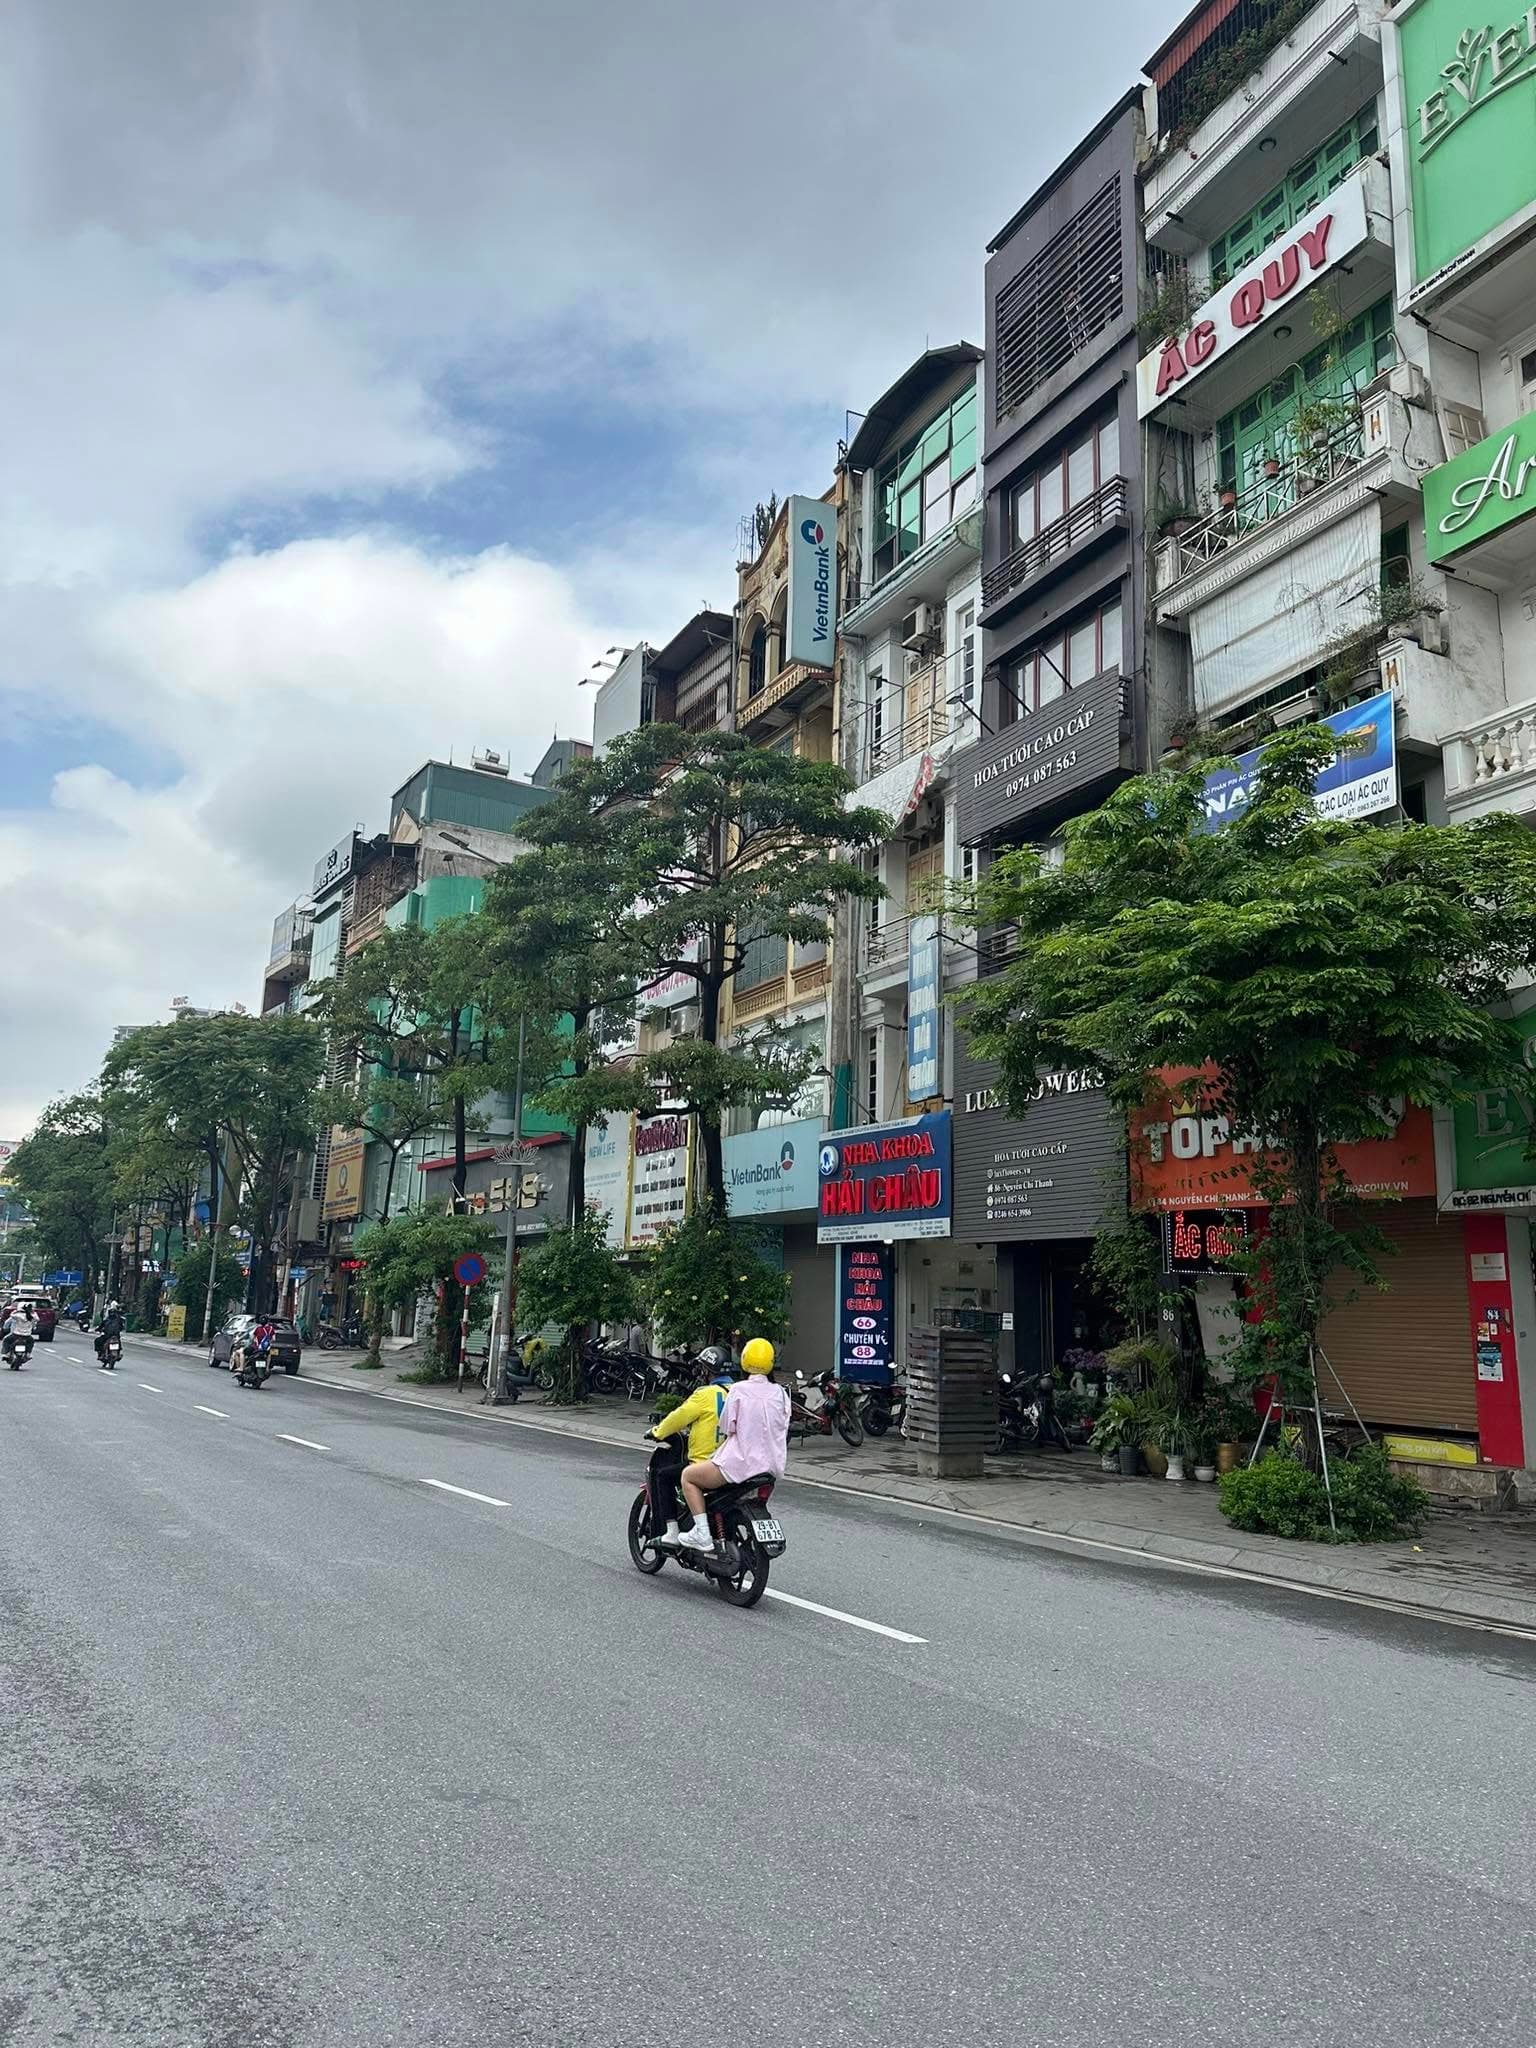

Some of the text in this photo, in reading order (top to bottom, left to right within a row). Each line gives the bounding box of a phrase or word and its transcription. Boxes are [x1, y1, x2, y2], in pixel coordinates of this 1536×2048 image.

[1155, 214, 1333, 396] ẮC QUY
[812, 545, 829, 642] VietinBank
[973, 703, 1094, 788] HOA TƯƠI CAO CẤP
[1006, 750, 1077, 798] 0974 087 563
[1337, 788, 1356, 808] LOẠI
[1371, 776, 1389, 795] QUY
[588, 1141, 616, 1158] NEW LIFE
[842, 1131, 935, 1167] NHA KHOA
[994, 1152, 1011, 1163] HOA
[1031, 1146, 1048, 1157] CAO
[731, 1161, 781, 1186] VietinBank
[821, 1164, 941, 1217] HẢI CHÂU
[1034, 1178, 1054, 1189] Thanh
[1204, 1191, 1219, 1203] CHÍ
[851, 1252, 879, 1264] NHA
[848, 1267, 883, 1280] KHOA
[854, 1280, 876, 1295] HẢI
[846, 1296, 883, 1311] CHÂU
[856, 1318, 872, 1328] 66
[1162, 1308, 1175, 1322] 86
[856, 1347, 871, 1356] 88
